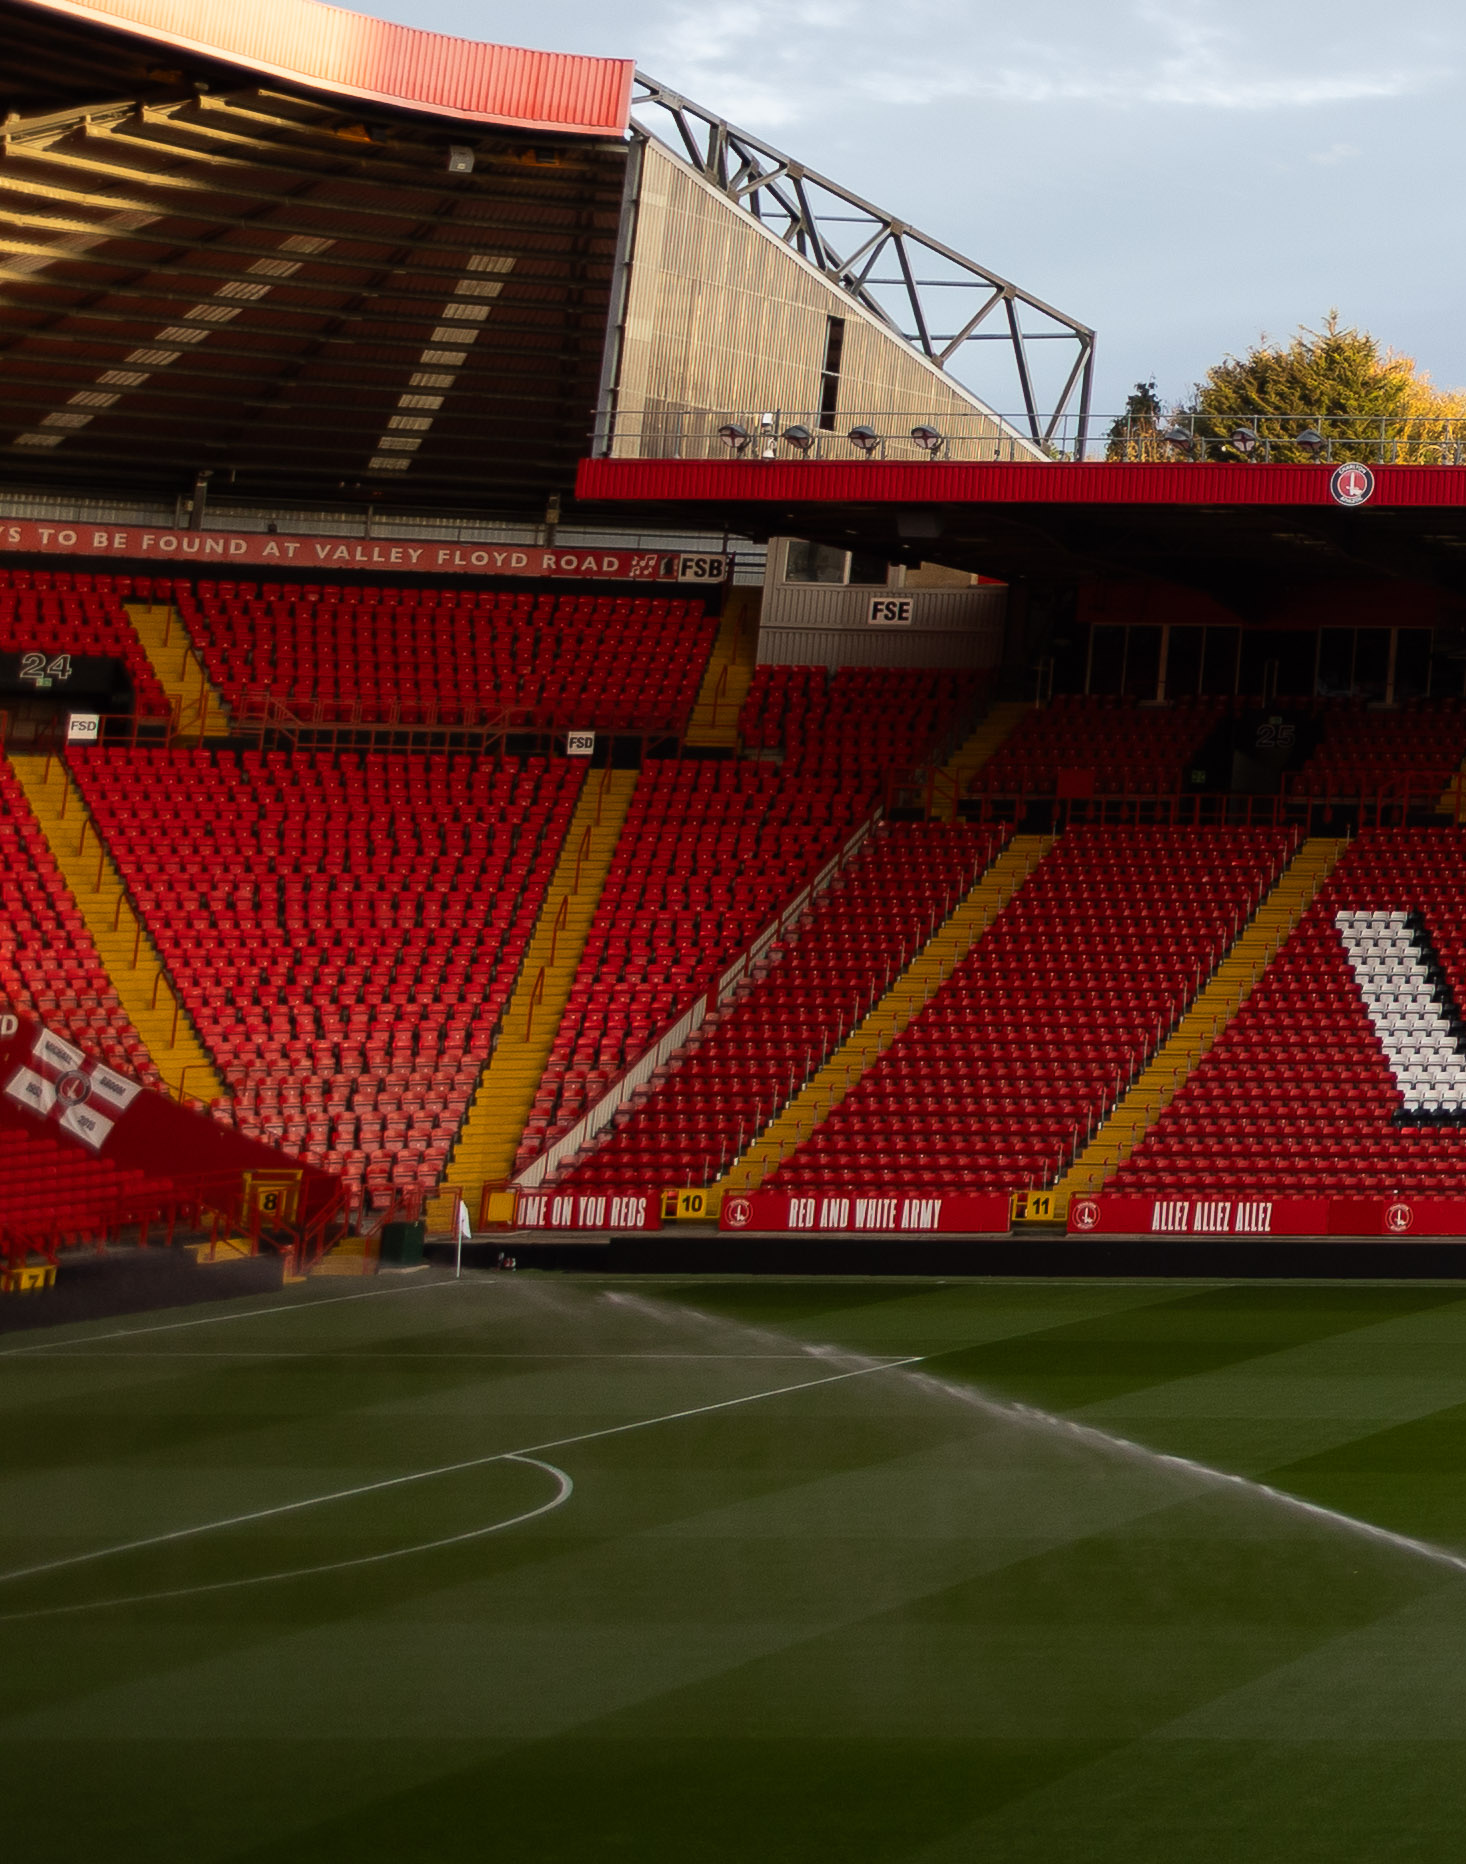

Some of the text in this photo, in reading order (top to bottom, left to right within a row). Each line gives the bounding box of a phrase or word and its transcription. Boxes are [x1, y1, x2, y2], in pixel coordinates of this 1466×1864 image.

[0, 526, 620, 572] S TO BE FOUND AT VALLEY FLOYD ROAD
[680, 557, 723, 578] FSB
[871, 599, 910, 622] FSE
[20, 653, 72, 679] 24
[71, 721, 96, 732] FSD
[1256, 724, 1296, 748] 25
[569, 736, 593, 750] FSD
[264, 1194, 277, 1210] 8
[517, 1196, 646, 1226] OME ON YOU REDS
[682, 1195, 702, 1212] 10
[789, 1199, 941, 1228] RED AND WHITE ARMY
[1033, 1197, 1049, 1214] 11
[1152, 1202, 1272, 1231] ALLEZ ALLEZ ALLEZ
